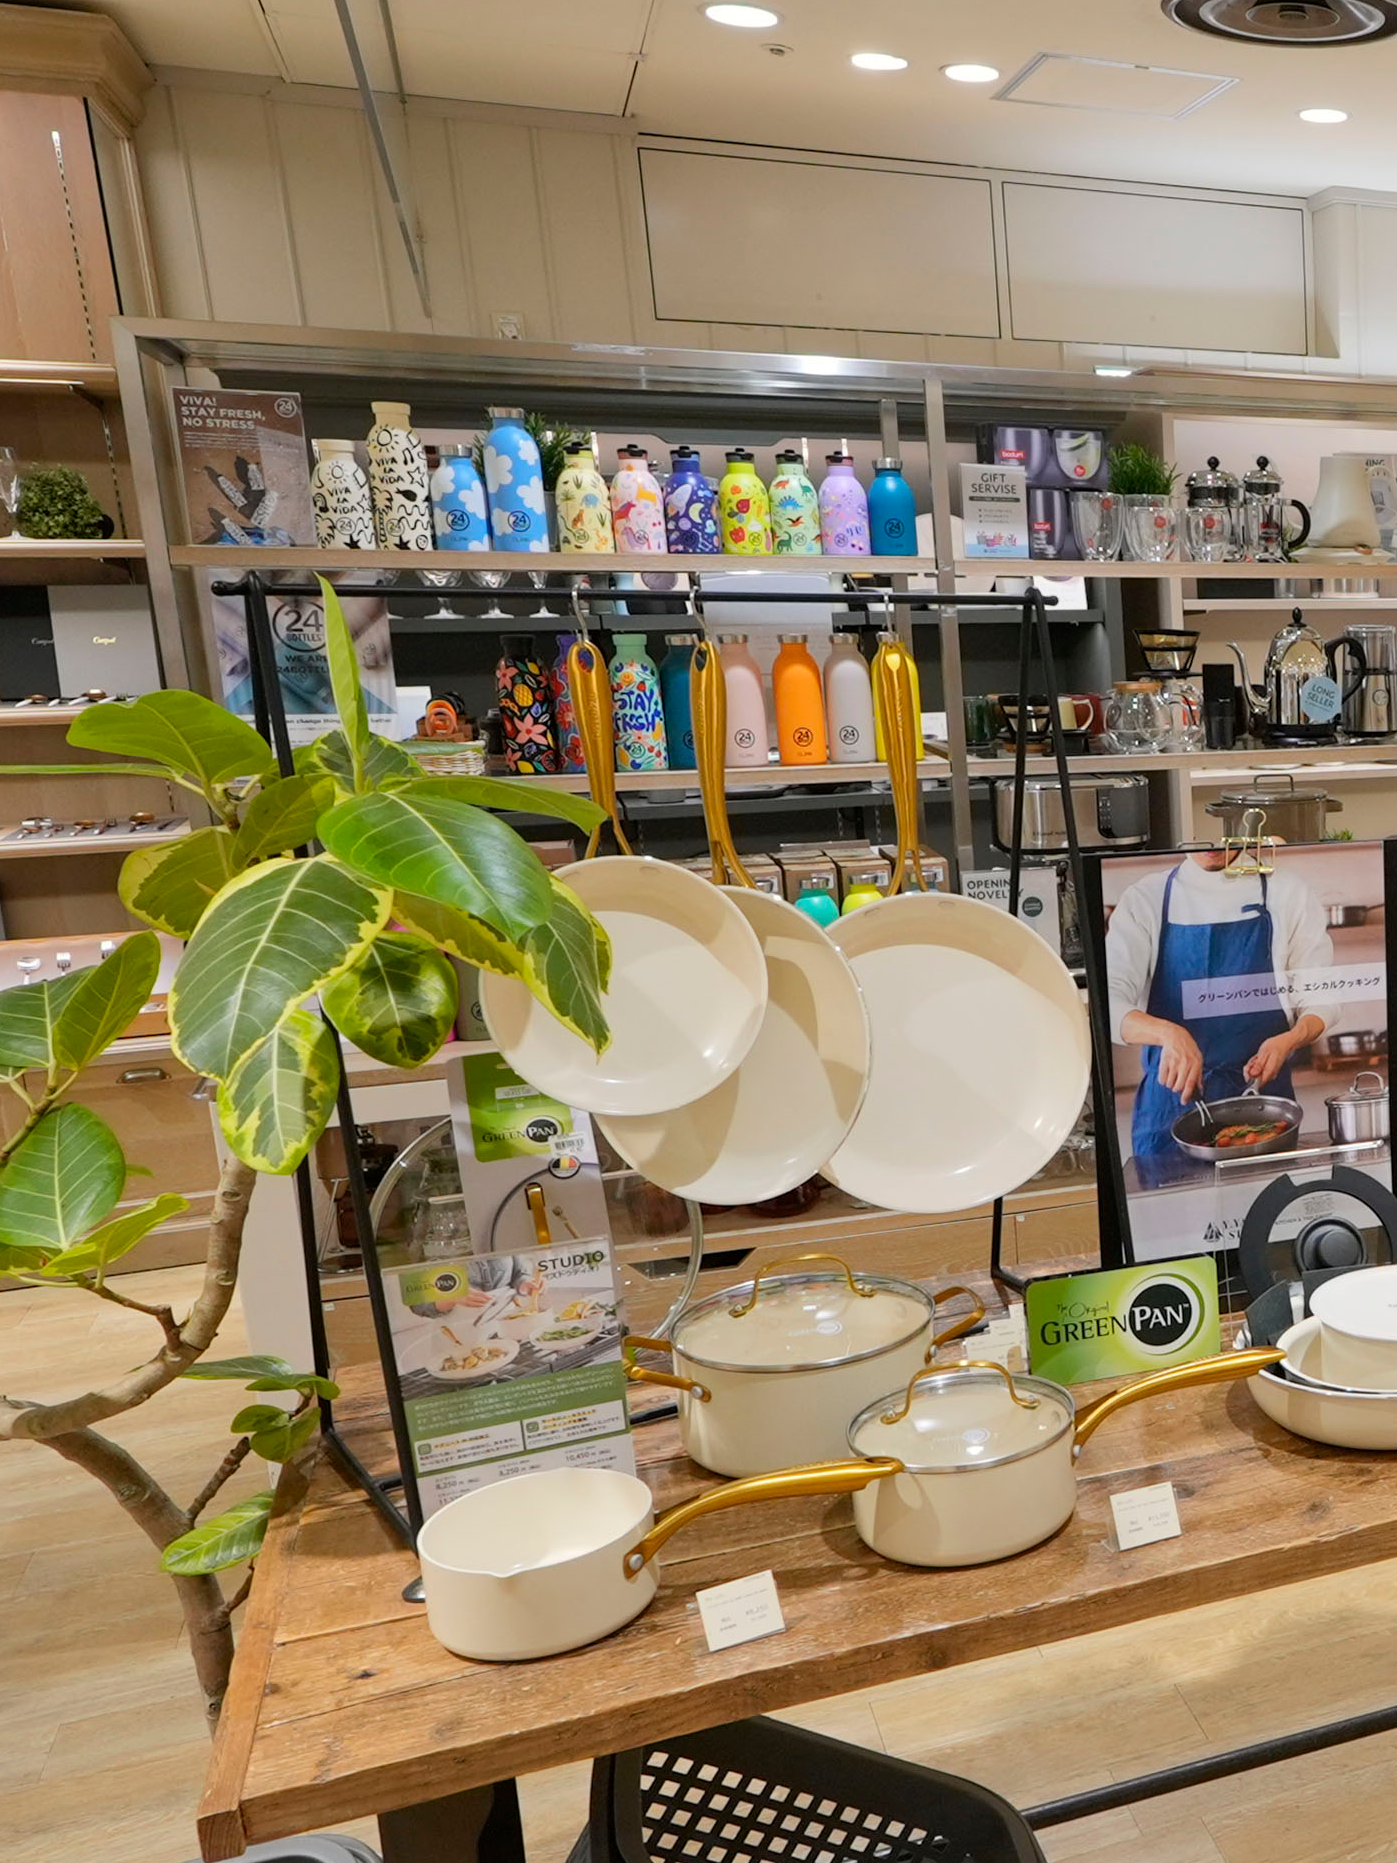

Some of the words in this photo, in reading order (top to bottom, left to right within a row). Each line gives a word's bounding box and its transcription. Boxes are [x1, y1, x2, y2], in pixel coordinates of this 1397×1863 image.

[179, 395, 217, 407] VIVA!
[180, 406, 216, 417] STAY
[219, 408, 266, 421] FRESH,
[183, 417, 203, 427] NO
[206, 418, 255, 430] STRESS
[981, 473, 1006, 483] GIFT
[971, 483, 1017, 495] SERVISE
[285, 609, 323, 633] 24
[286, 633, 322, 642] BOTTLES
[1312, 684, 1335, 699] LONG
[611, 689, 654, 712] STAY
[1306, 692, 1335, 708] SELLER
[967, 879, 1011, 890] OPENIN
[538, 1250, 604, 1272] STUDIO
